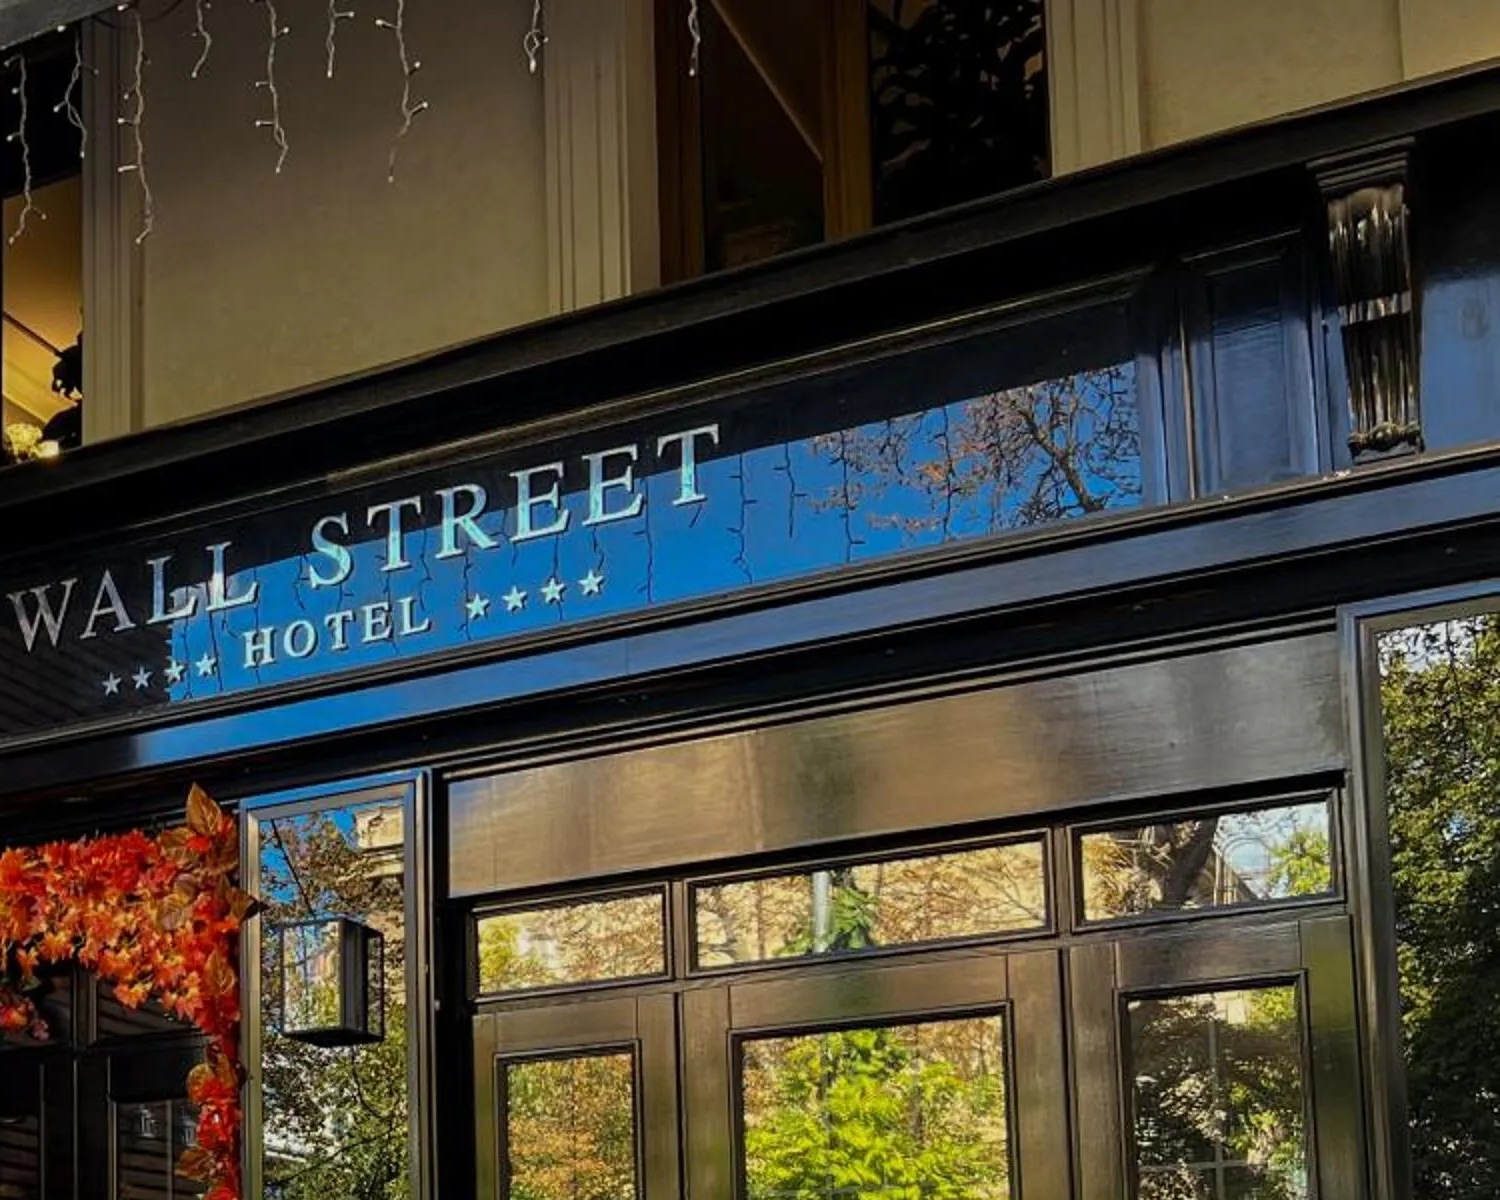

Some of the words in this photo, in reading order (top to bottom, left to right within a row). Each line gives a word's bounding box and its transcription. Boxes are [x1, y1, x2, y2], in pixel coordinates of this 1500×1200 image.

[6, 540, 258, 653] WALL
[309, 423, 720, 589] STREET
[242, 597, 431, 670] HOTEL
